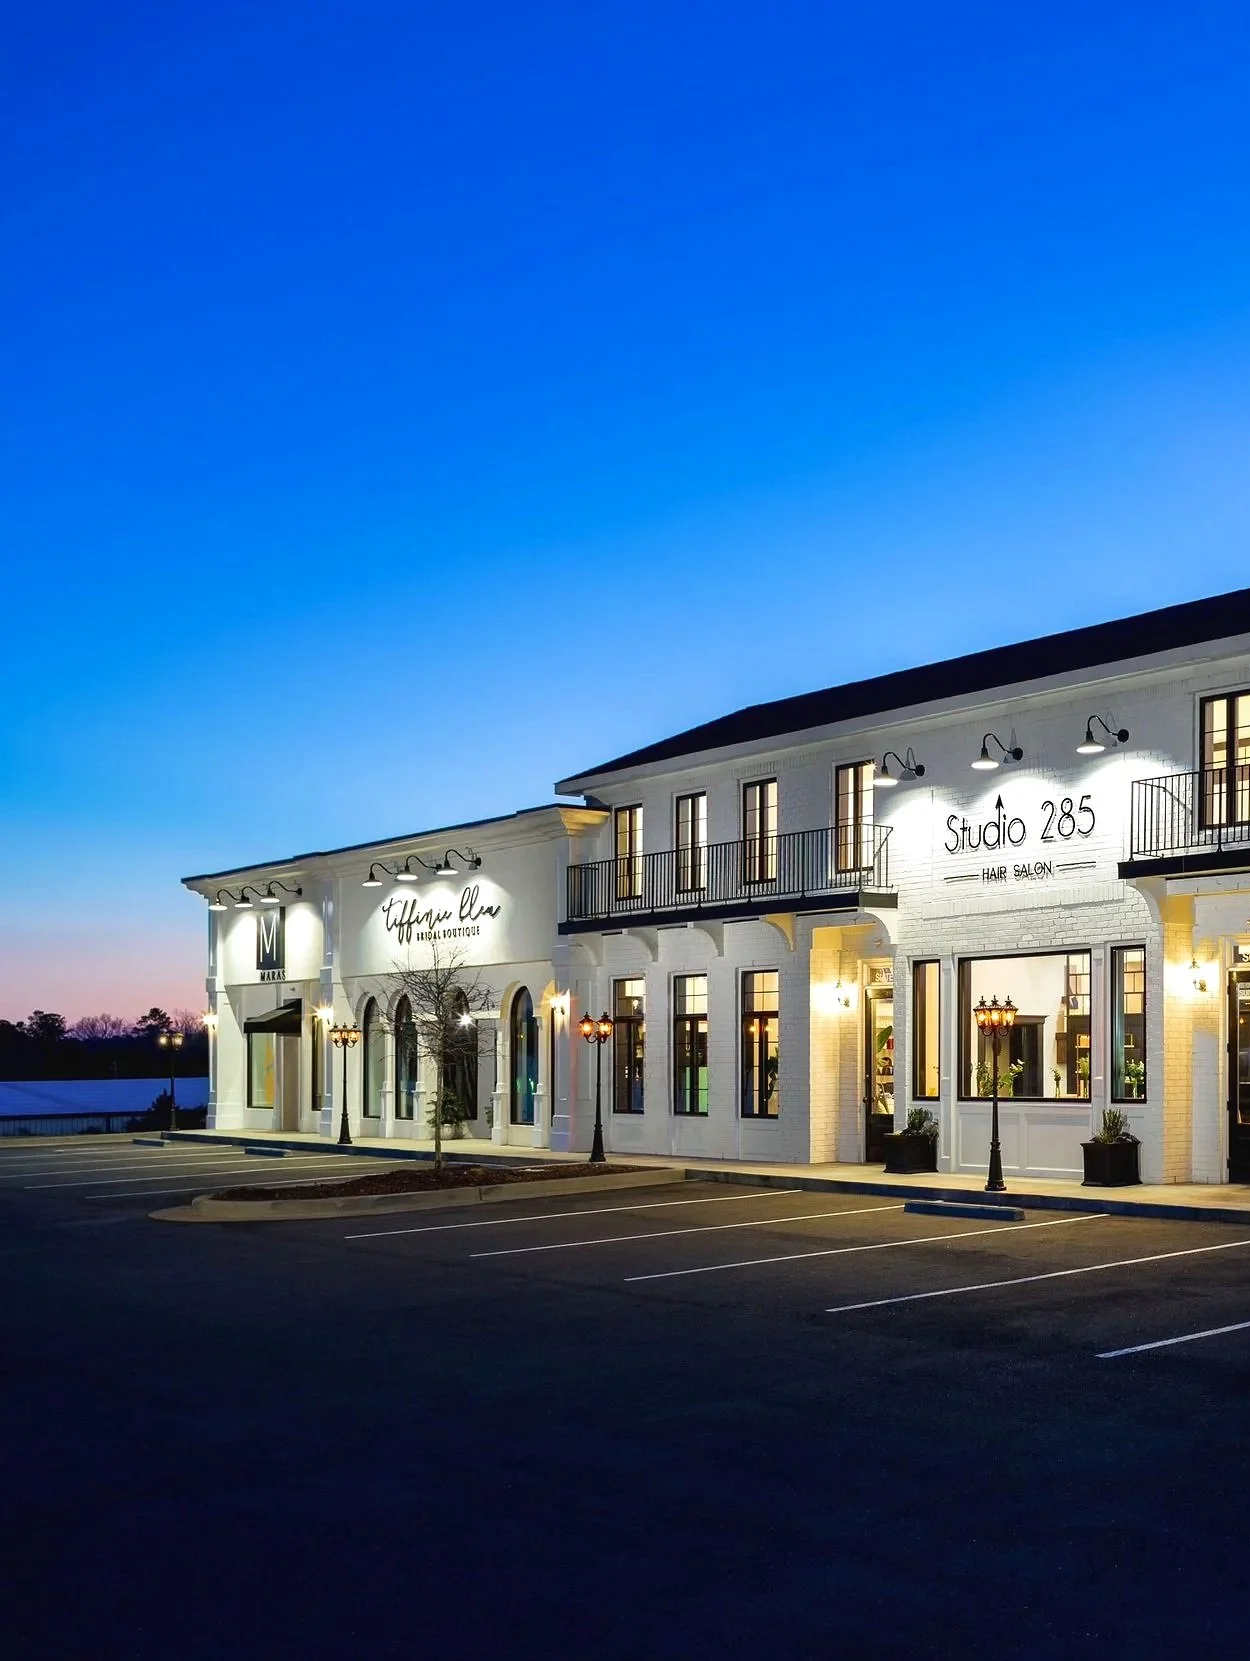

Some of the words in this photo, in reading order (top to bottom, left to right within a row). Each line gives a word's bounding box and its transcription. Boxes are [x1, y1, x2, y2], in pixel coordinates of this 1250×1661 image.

[945, 794, 1026, 852] Studio
[1041, 795, 1095, 840] 285
[982, 866, 1007, 881] HAIR
[1013, 861, 1052, 878] SALON
[260, 914, 277, 963] M
[416, 930, 441, 942] BRIDAL
[443, 926, 480, 939] BOUTIQUE
[260, 970, 286, 981] MARAS
